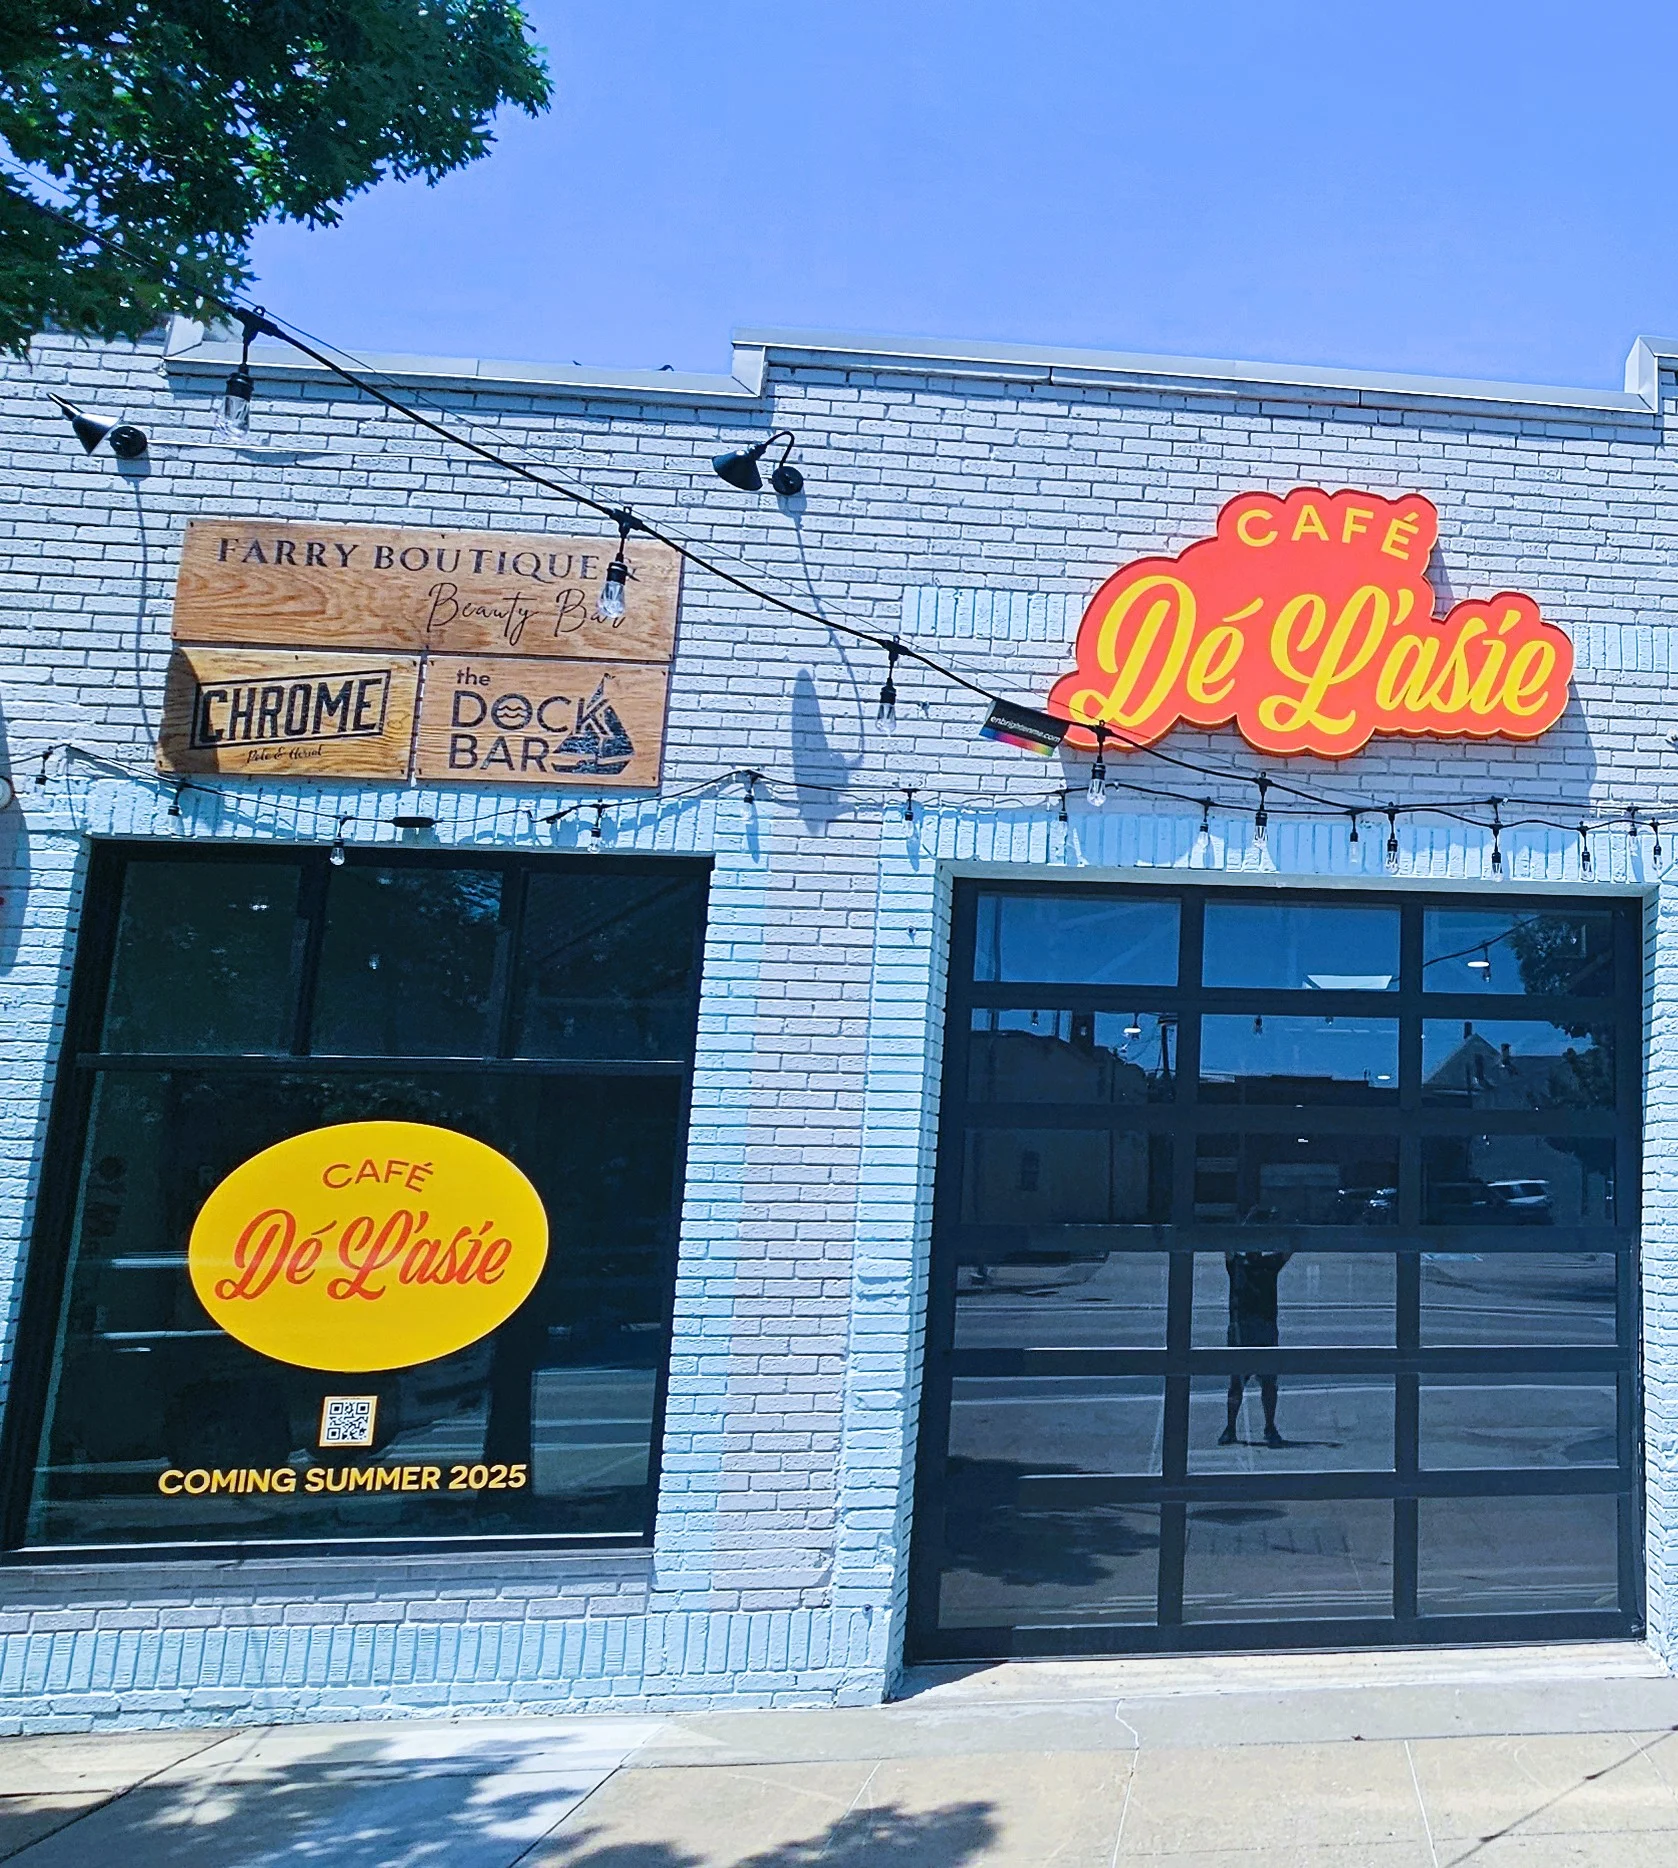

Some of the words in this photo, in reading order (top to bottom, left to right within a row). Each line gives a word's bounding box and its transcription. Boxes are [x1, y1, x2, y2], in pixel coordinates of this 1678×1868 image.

[1236, 503, 1421, 561] CAFÉ
[217, 537, 361, 569] FARRY
[373, 545, 600, 584] BOUTIQUE
[428, 582, 540, 646] Beauty
[554, 588, 627, 638] Bar
[1070, 575, 1263, 729] Dé
[456, 667, 491, 686] the
[200, 677, 384, 743] CHROME
[451, 690, 612, 738] DOCK
[274, 745, 285, 760] &
[449, 733, 549, 773] BAR
[322, 1158, 434, 1193] CAFÉ
[214, 1208, 338, 1301] Dé
[158, 1467, 296, 1495] COMING
[304, 1465, 440, 1493] SUMMER
[448, 1463, 528, 1490] 2025
